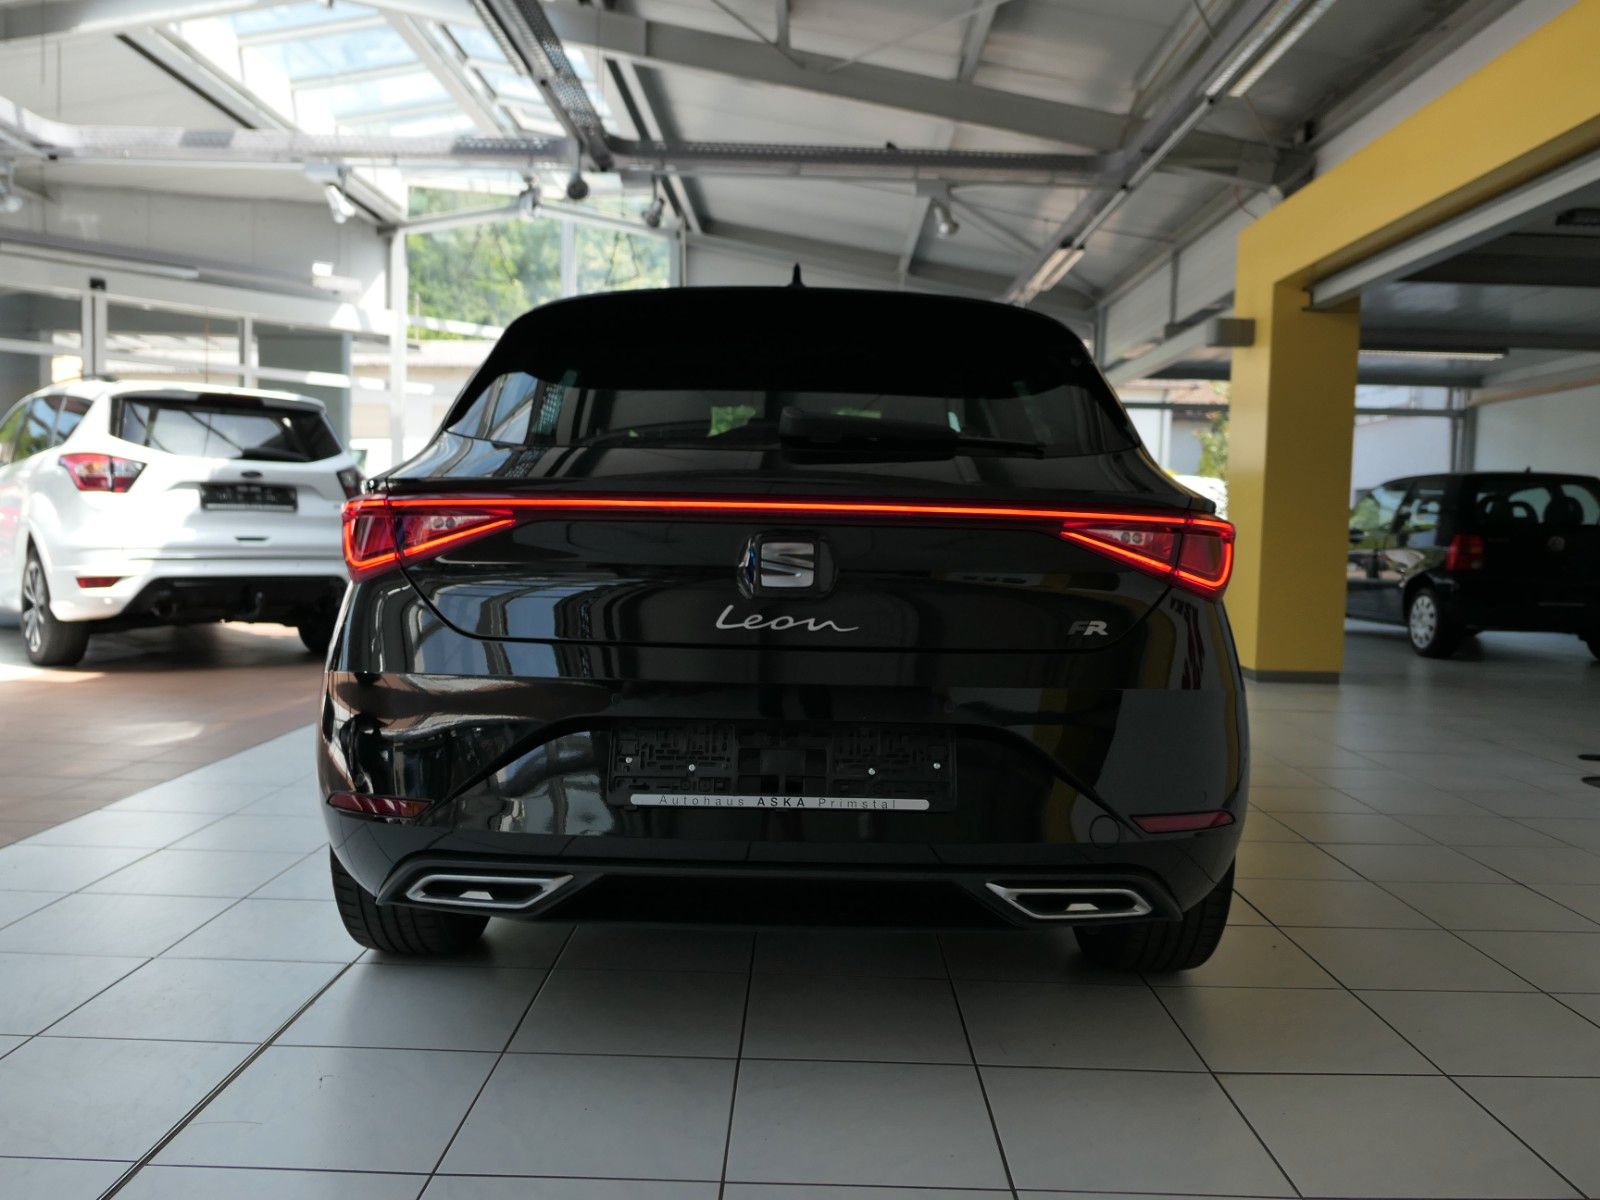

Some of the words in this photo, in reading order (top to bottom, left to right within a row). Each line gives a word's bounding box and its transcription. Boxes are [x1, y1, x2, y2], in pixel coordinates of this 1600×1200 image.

[715, 605, 859, 632] Leon
[1069, 620, 1108, 637] FR
[659, 795, 745, 807] Autohaus
[757, 797, 806, 808] ASKA
[818, 798, 897, 809] Primstal
